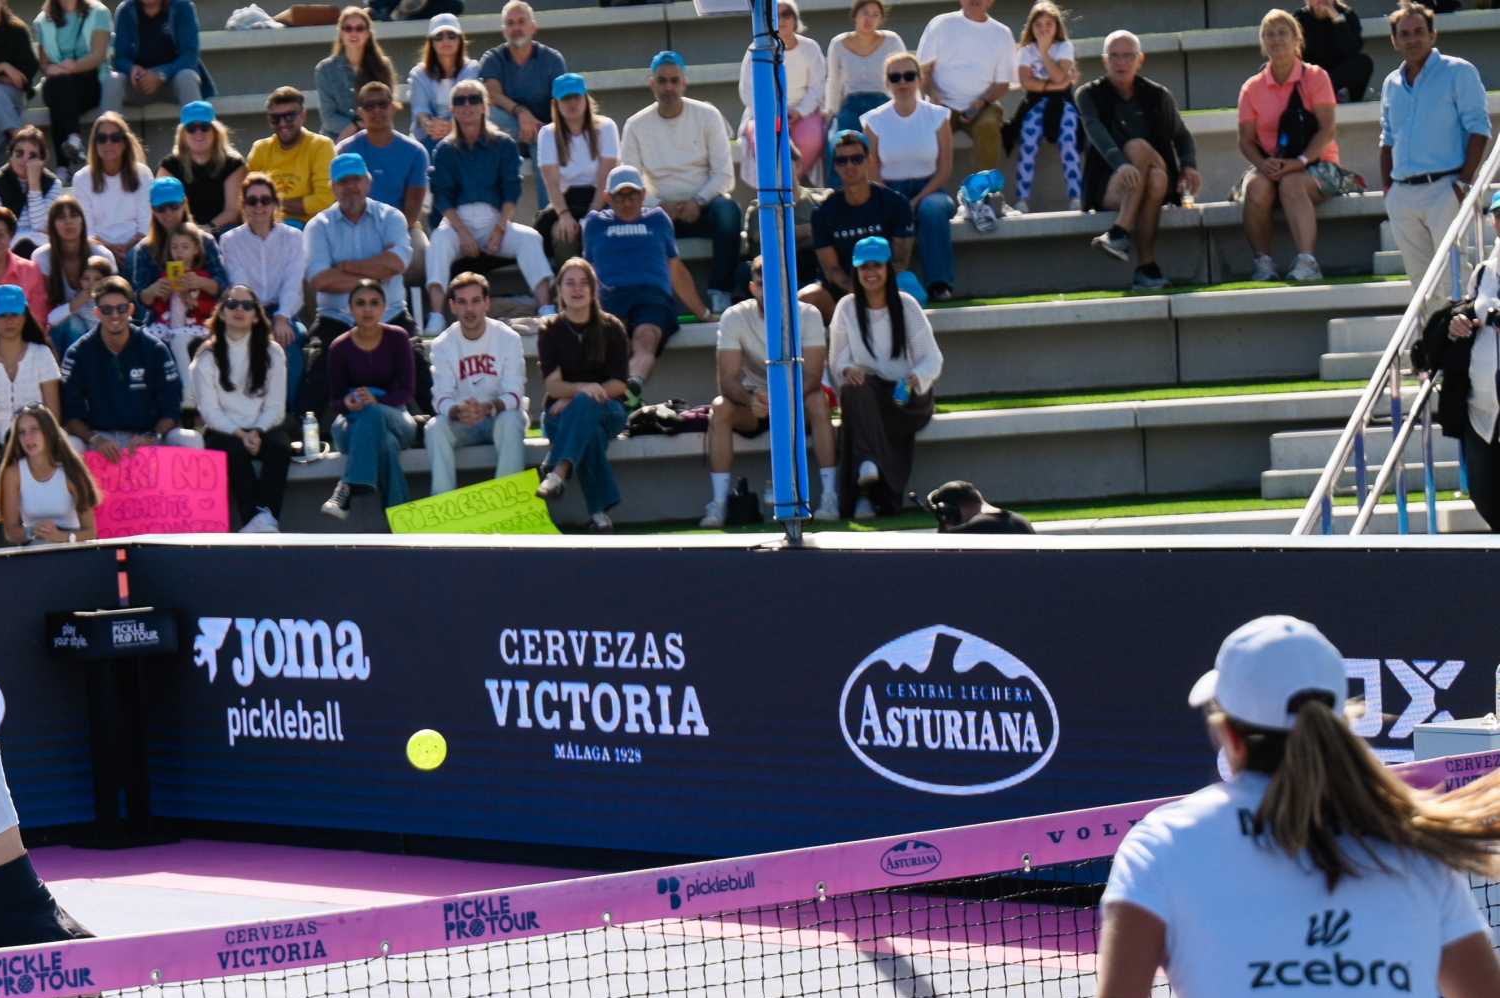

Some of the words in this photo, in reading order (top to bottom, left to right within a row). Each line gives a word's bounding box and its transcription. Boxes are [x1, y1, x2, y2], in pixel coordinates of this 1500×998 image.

[606, 223, 649, 237] PUMA
[459, 353, 498, 381] NIKE
[171, 453, 218, 491] NO
[391, 480, 532, 533] PICKLEBALL
[499, 628, 686, 670] CERVEZAS
[886, 682, 956, 699] CENTRAL
[961, 685, 1033, 702] LECHERA
[227, 698, 345, 747] pickleball
[485, 679, 710, 737] VICTORIA
[857, 684, 1043, 753] ASTURIANA
[554, 741, 611, 762] MÁLAGA
[614, 746, 642, 764] 1928
[1445, 754, 1500, 772] CERVEZ
[1046, 818, 1143, 844] VOL
[885, 854, 938, 870] ASTURIANA
[686, 871, 755, 901] picklebull
[225, 920, 318, 945] CERVEZAS
[217, 940, 327, 970] VICTORIA
